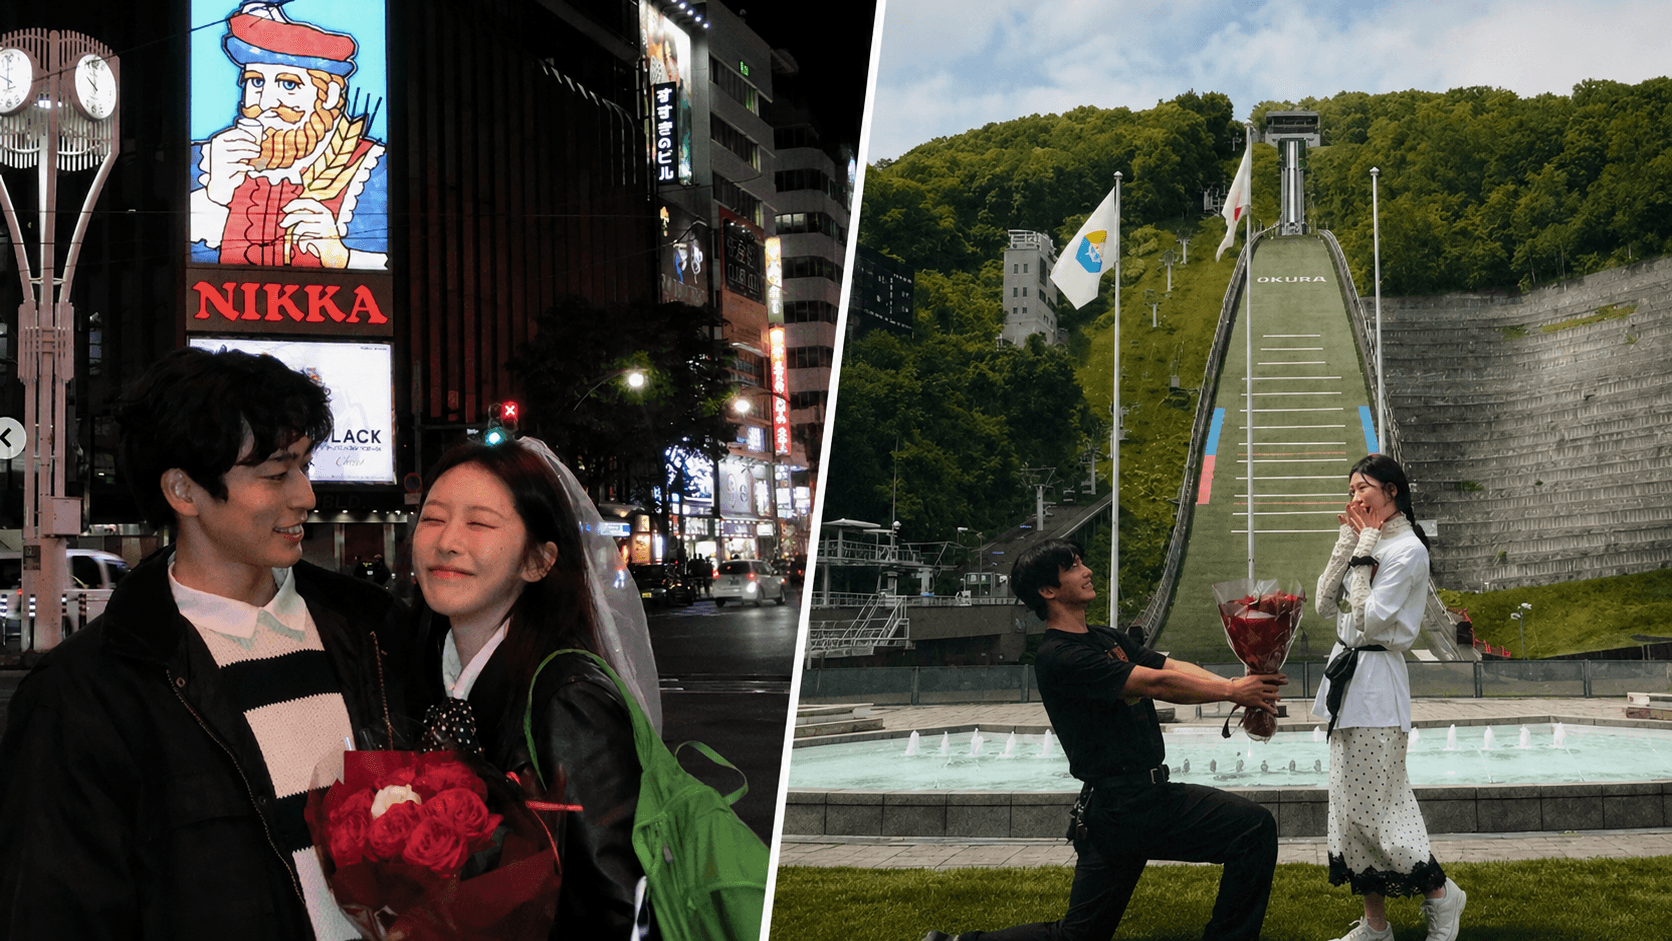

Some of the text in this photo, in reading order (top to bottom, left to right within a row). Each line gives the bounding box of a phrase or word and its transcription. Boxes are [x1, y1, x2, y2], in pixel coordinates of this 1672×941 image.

[656, 87, 675, 182] すすきのビル
[192, 280, 389, 324] NIKKA
[327, 429, 381, 443] LACK
